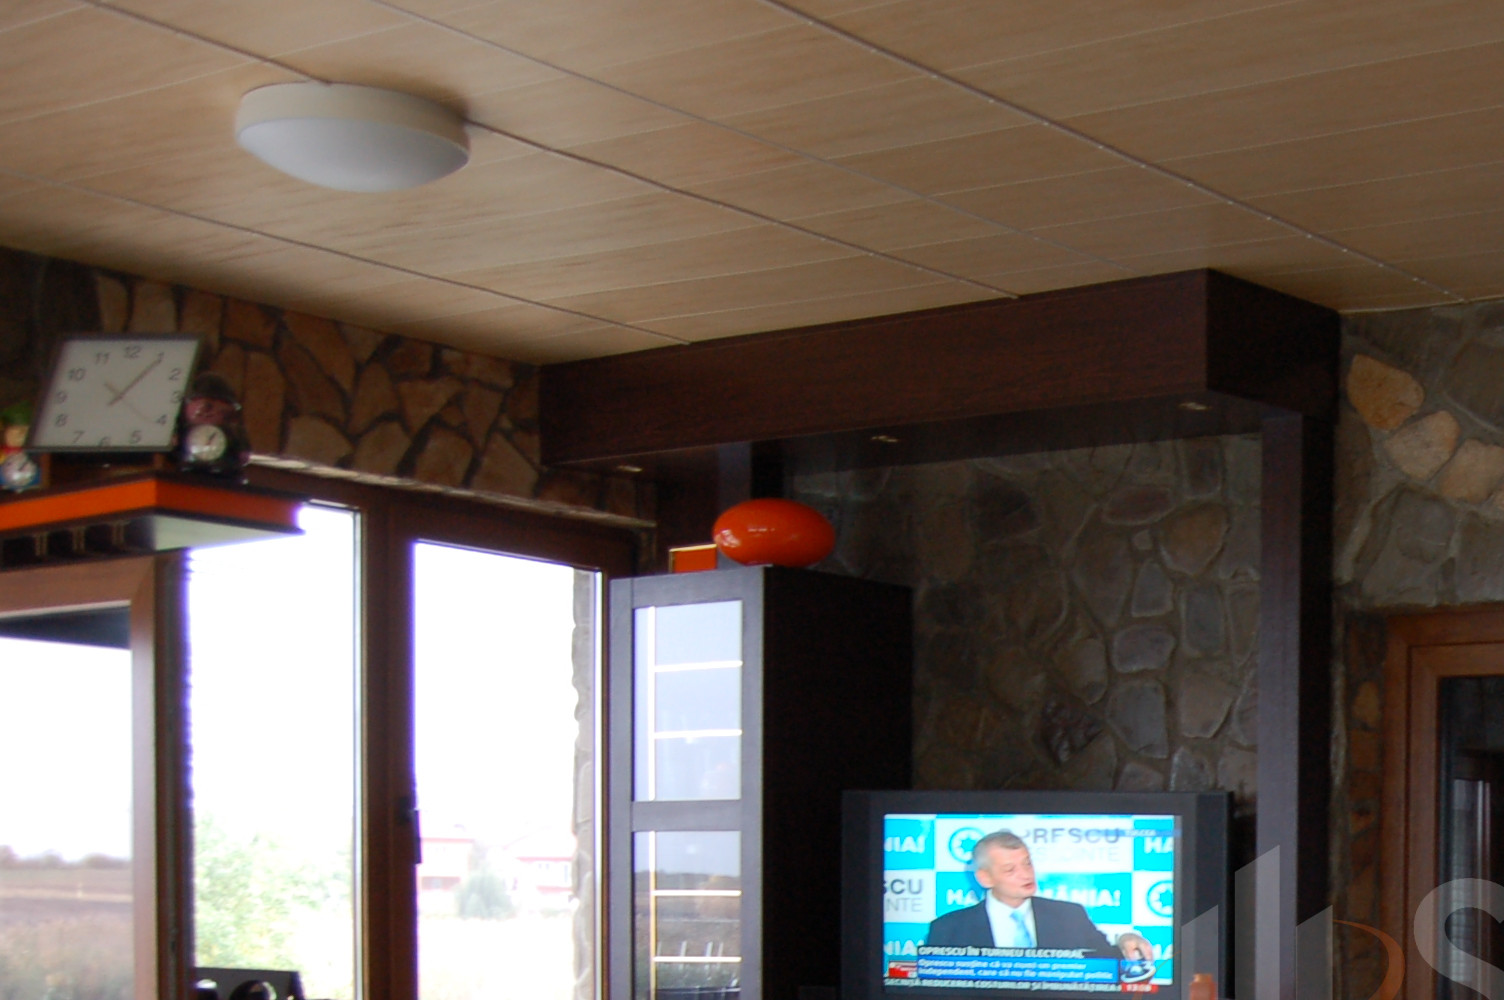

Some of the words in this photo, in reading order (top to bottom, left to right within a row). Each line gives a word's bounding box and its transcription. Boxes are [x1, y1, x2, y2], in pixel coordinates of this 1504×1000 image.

[95, 351, 110, 364] 11
[124, 345, 142, 359] 12
[68, 367, 86, 381] 10
[168, 367, 182, 381] 2
[55, 390, 68, 404] 9
[54, 413, 69, 428] 8
[155, 413, 167, 426] 4
[72, 430, 85, 444] 7
[129, 430, 142, 444] 5
